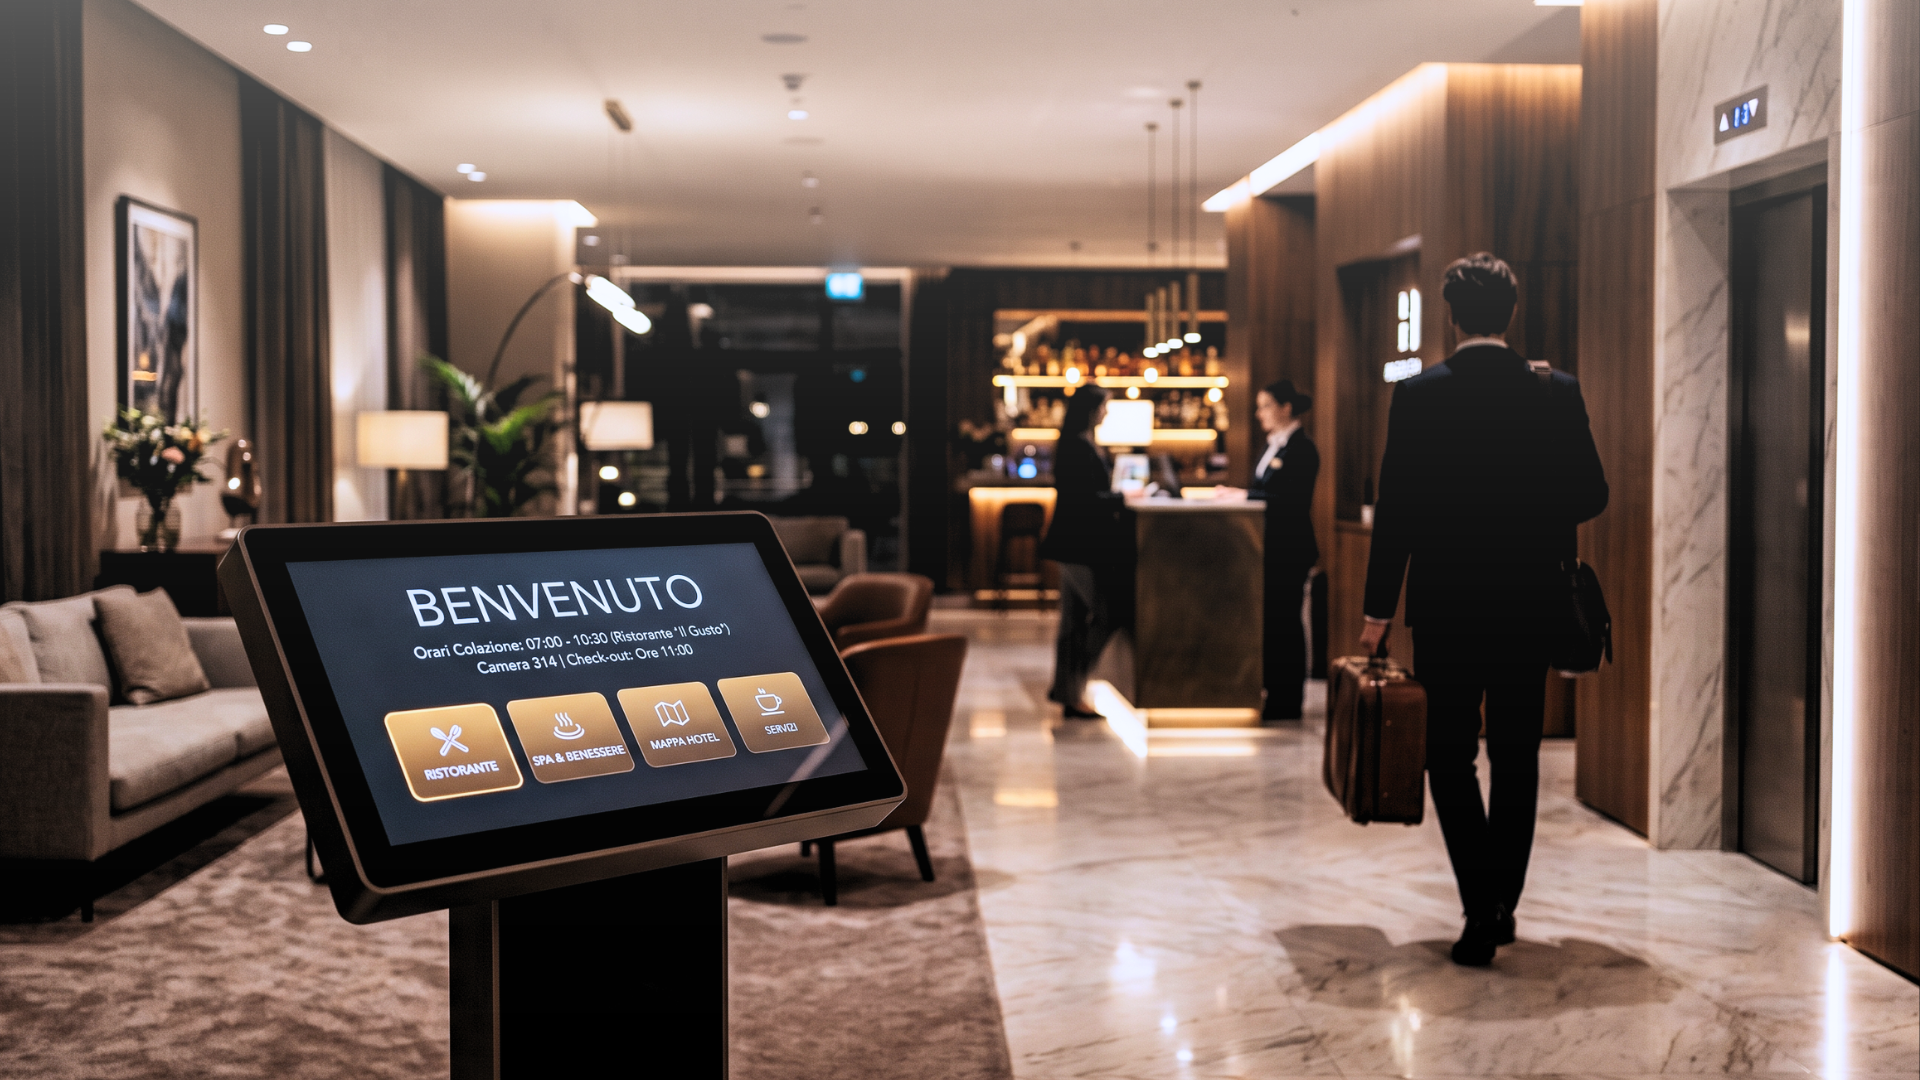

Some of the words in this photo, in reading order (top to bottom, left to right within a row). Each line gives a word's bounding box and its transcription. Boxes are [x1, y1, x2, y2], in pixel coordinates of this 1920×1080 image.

[405, 574, 703, 627] BENVENUTO
[413, 644, 451, 660] Orari
[452, 640, 525, 656] Colazione:
[525, 635, 563, 651] 07:00
[573, 632, 609, 646] 10:30
[610, 628, 674, 645] (Ristorante
[476, 661, 531, 675] Camera
[531, 655, 558, 669] 314
[566, 650, 634, 666] Check-out:
[635, 647, 660, 660] Ore
[660, 643, 694, 657] 11:00
[764, 722, 799, 735] SERVIZI
[650, 737, 686, 750] MAPPA
[686, 732, 721, 746] HOTEL
[532, 755, 555, 767] SPA
[555, 752, 565, 763] &
[567, 745, 627, 762] BENESSERE
[424, 760, 500, 781] RISTORANTE
